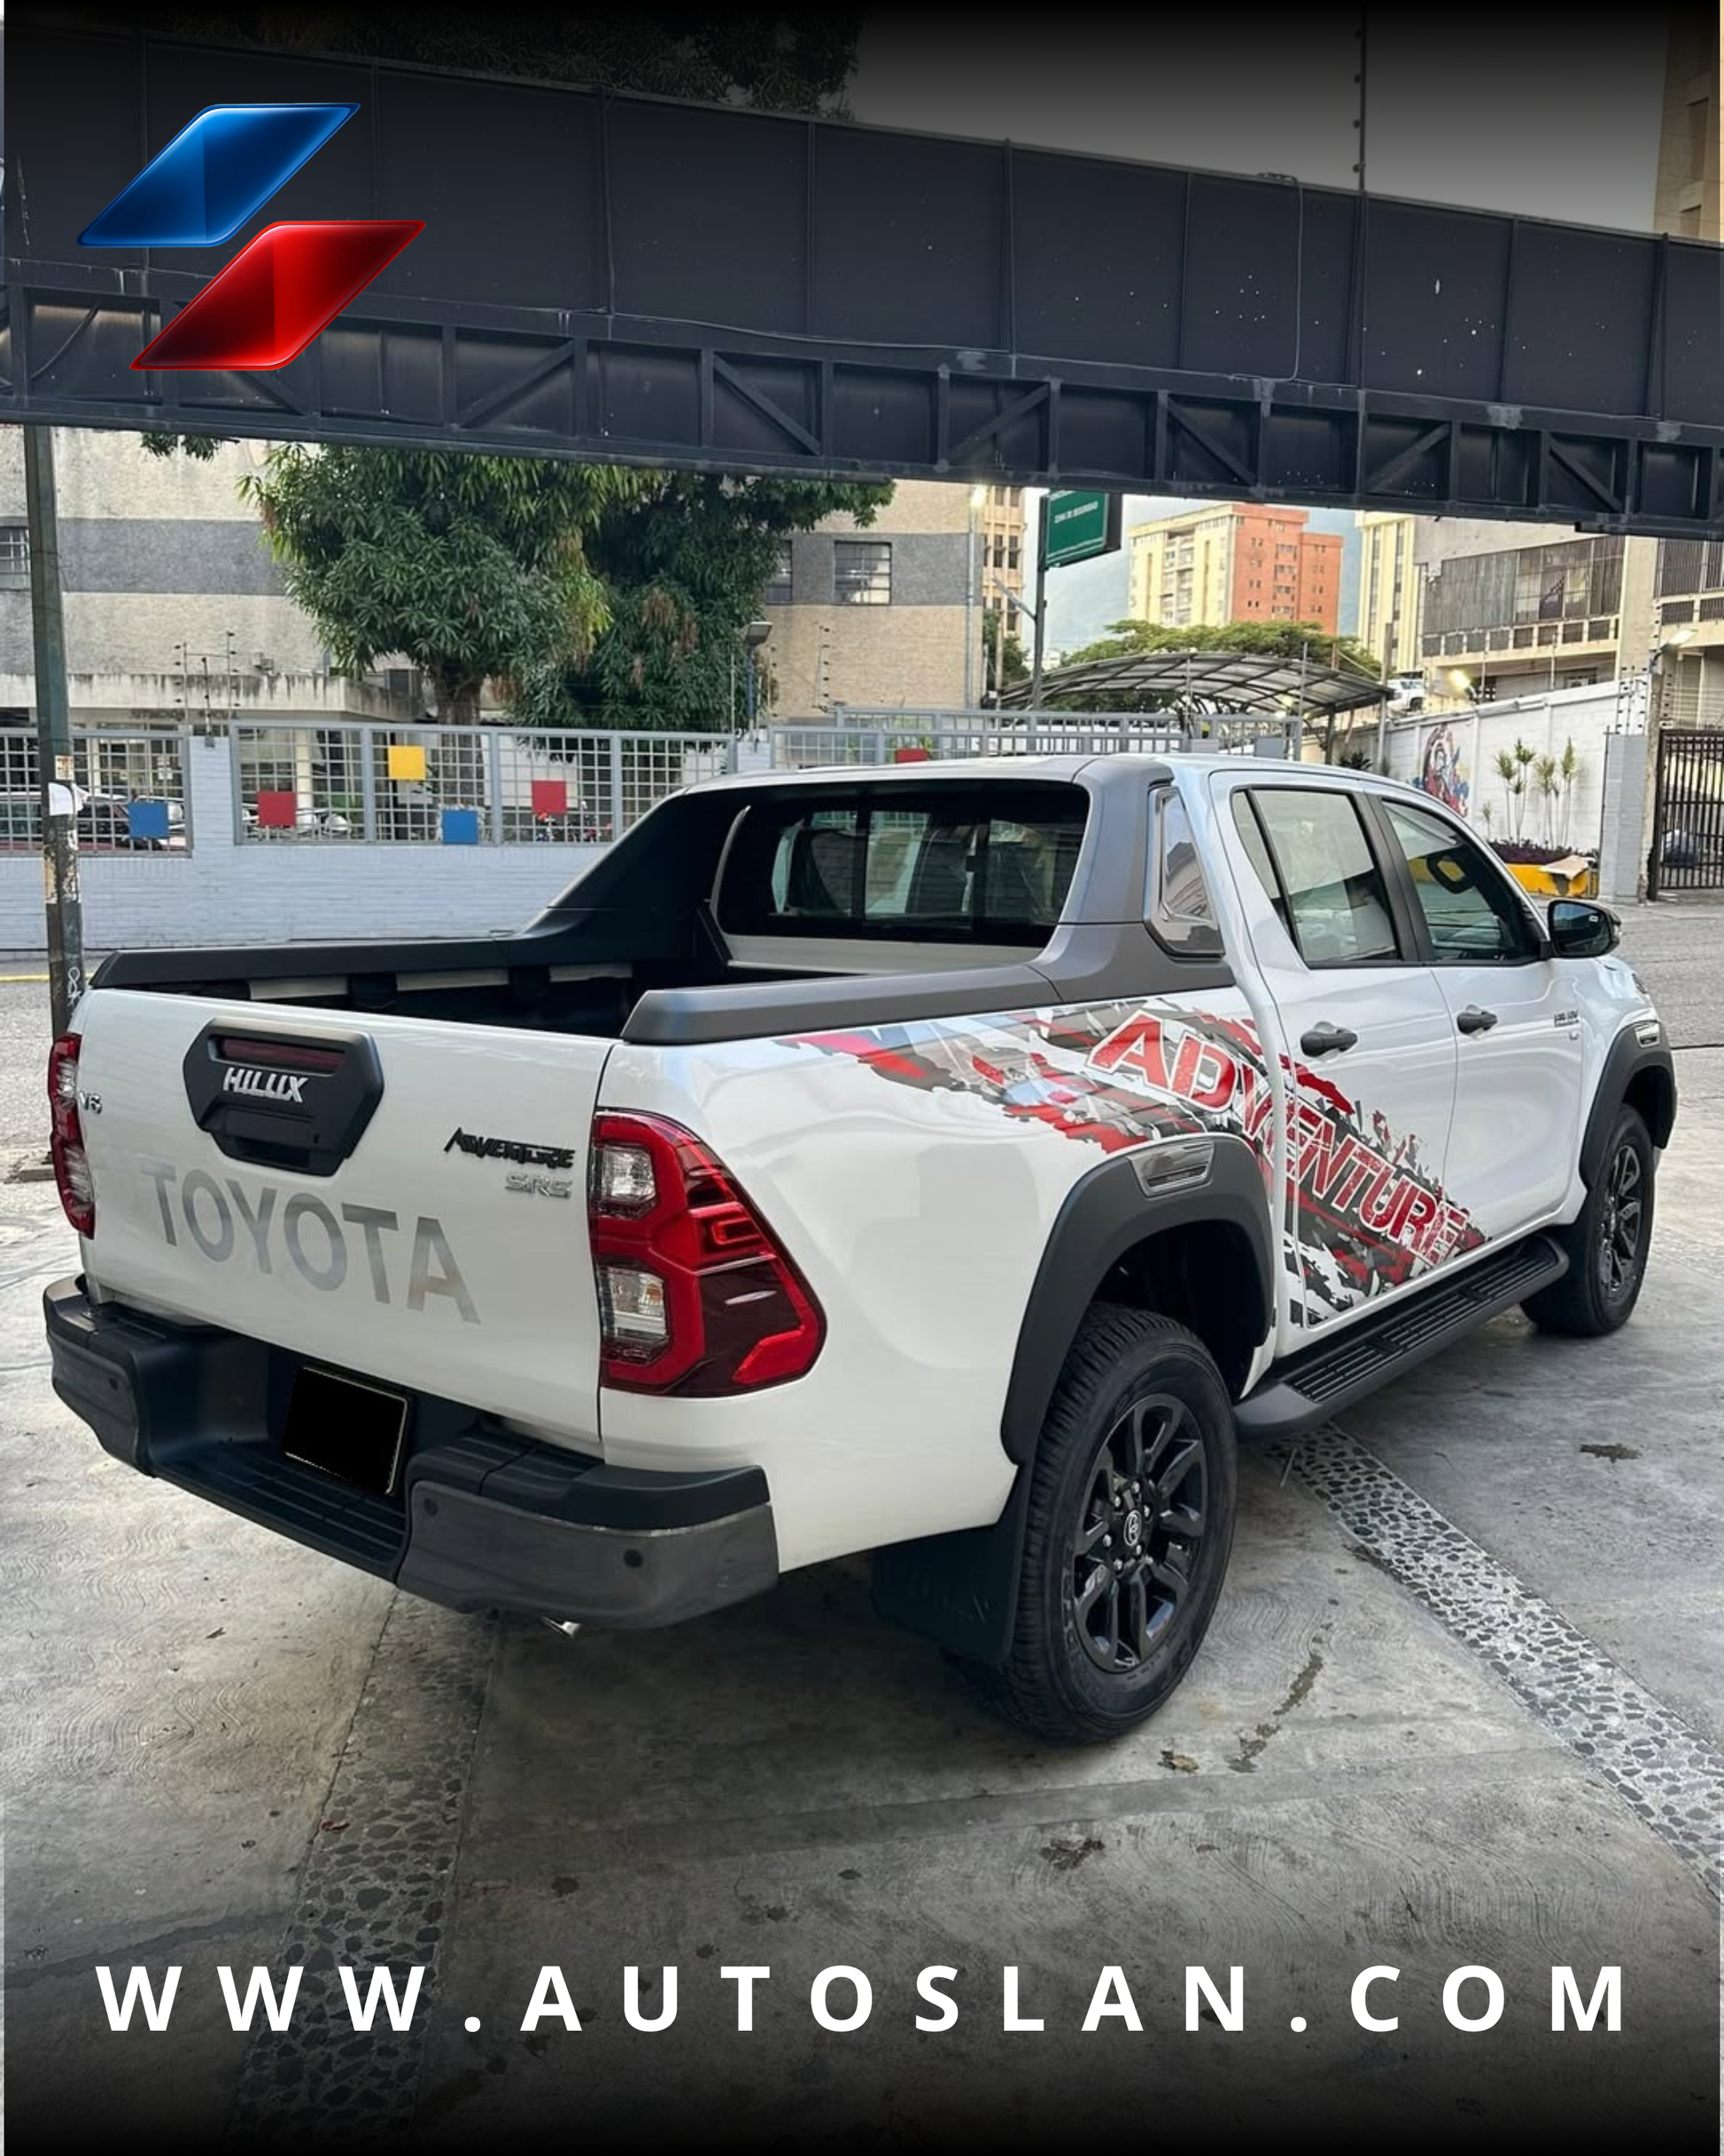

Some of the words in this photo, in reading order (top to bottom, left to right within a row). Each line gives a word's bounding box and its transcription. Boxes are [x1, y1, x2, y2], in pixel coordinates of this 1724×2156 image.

[79, 1091, 103, 1115] V6
[222, 1066, 309, 1103] HILUX
[1085, 1009, 1468, 1265] ADVENTURE
[139, 1161, 482, 1326] TOYOTA
